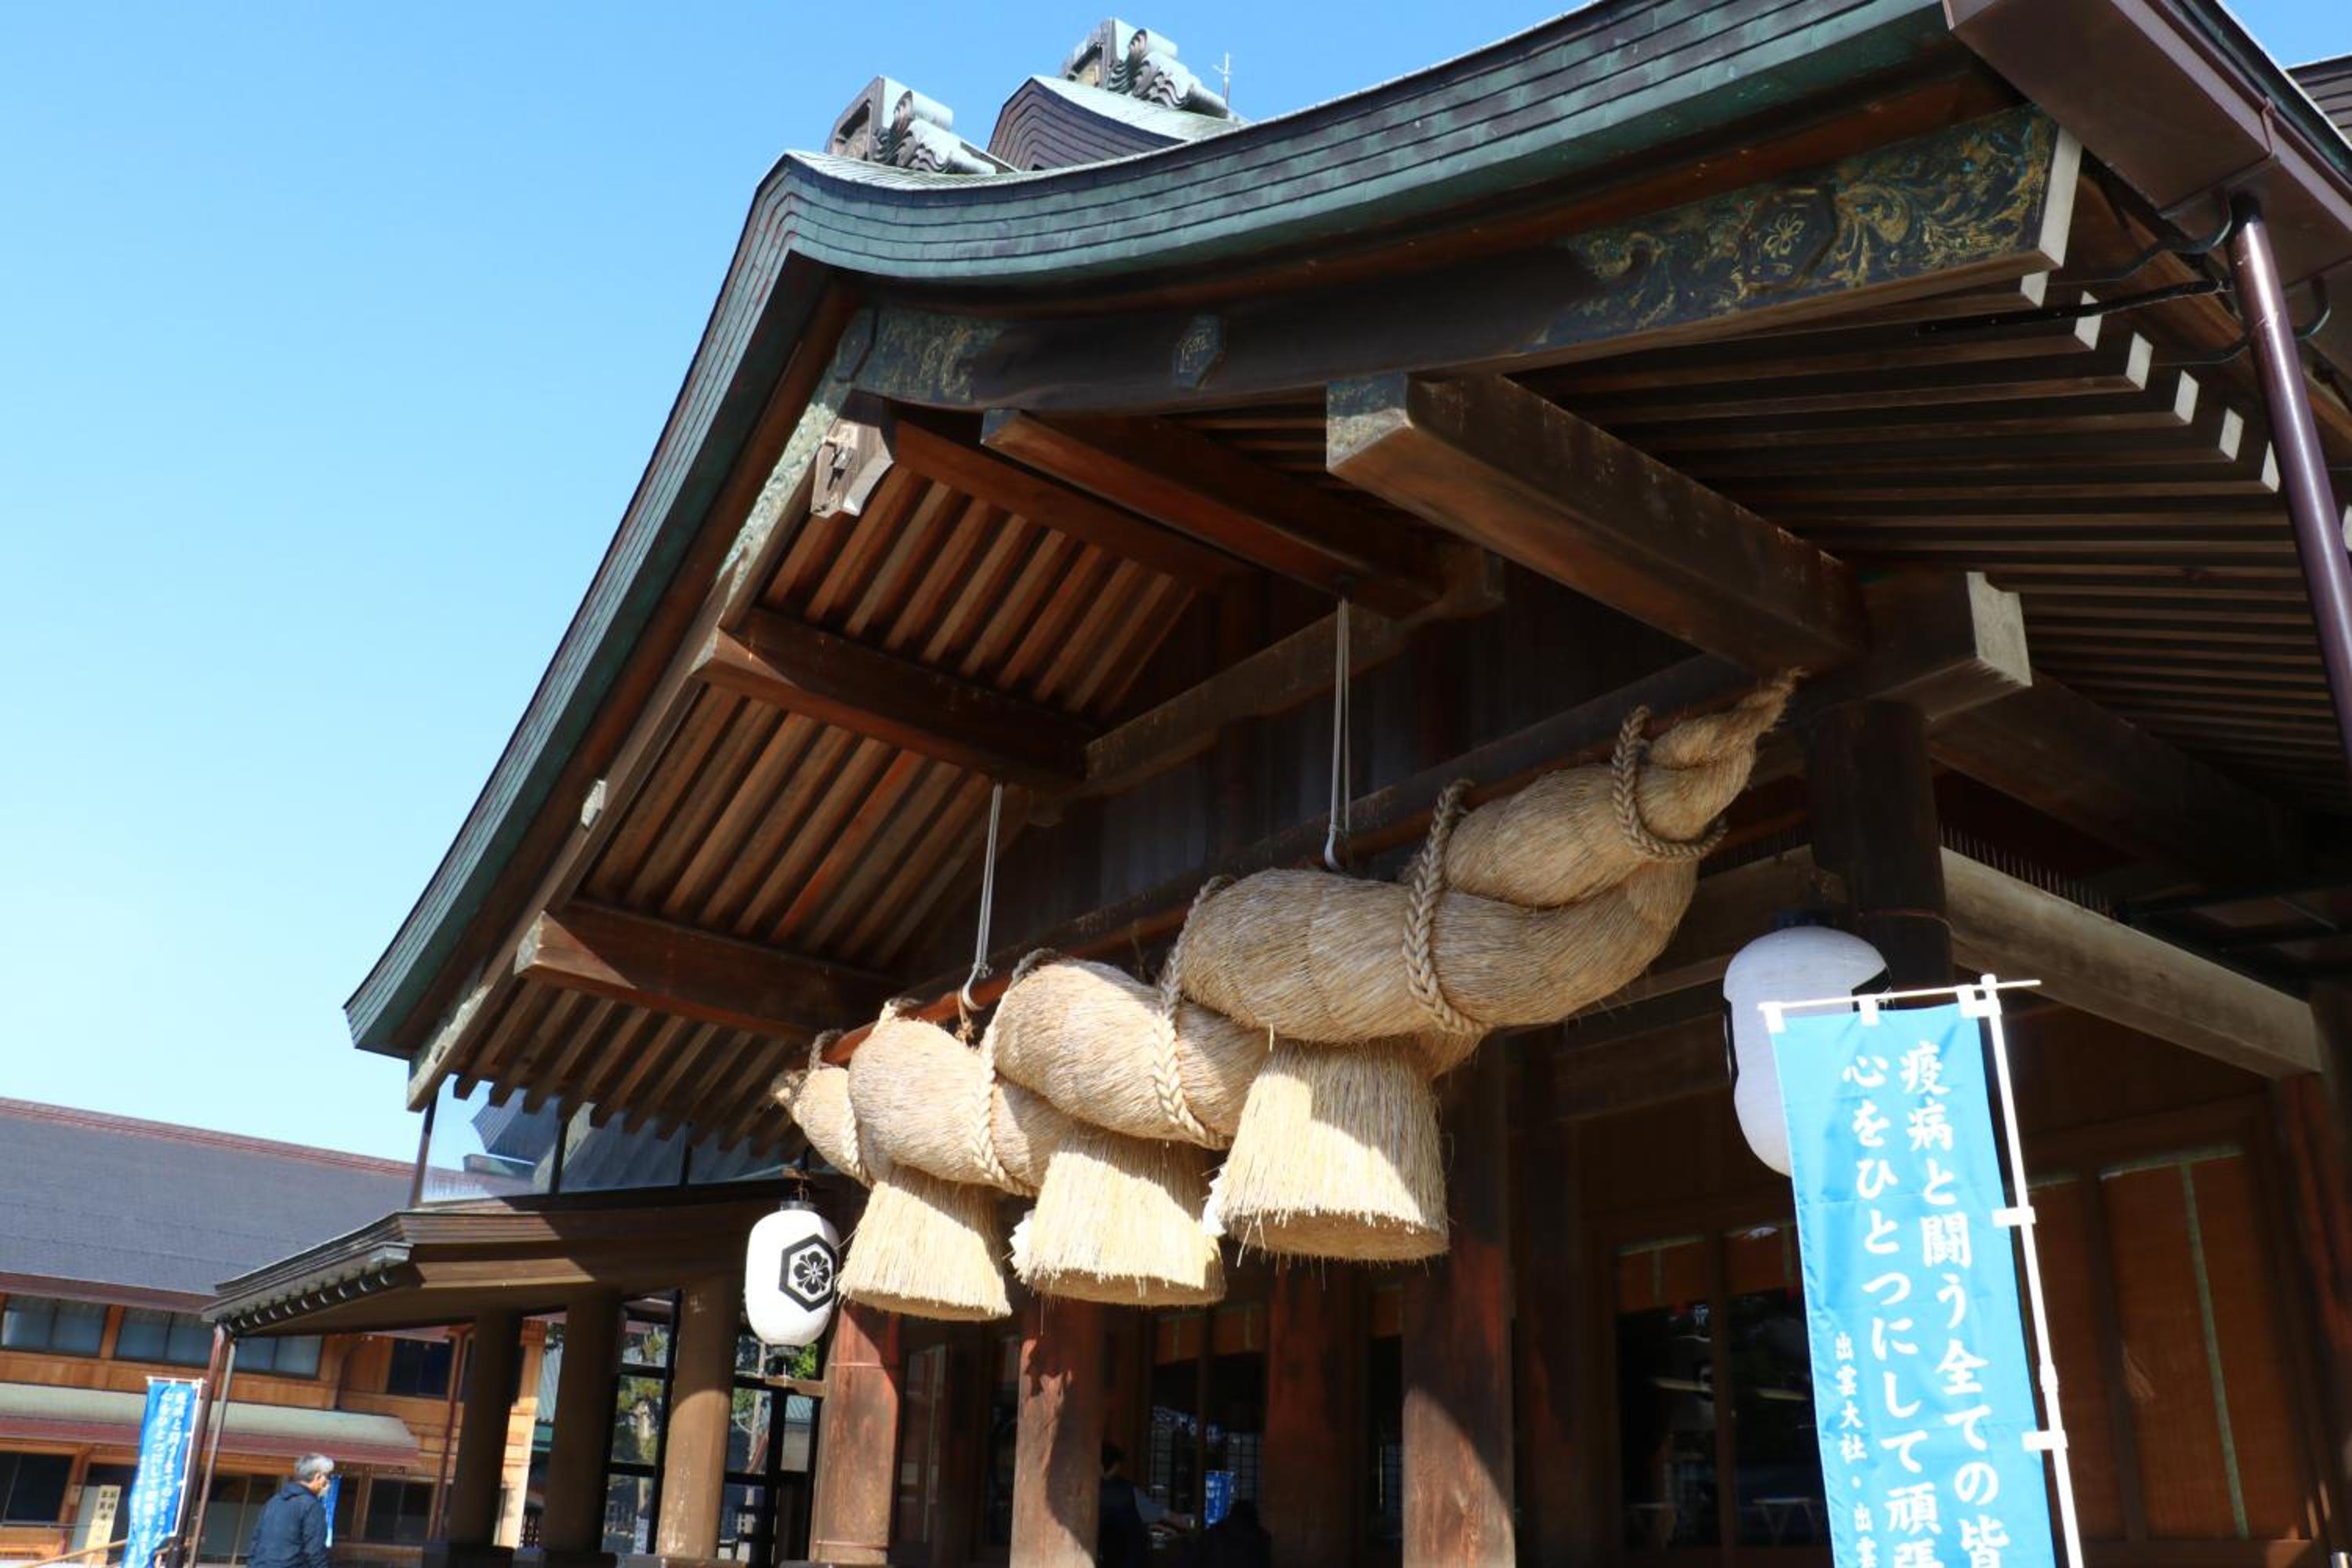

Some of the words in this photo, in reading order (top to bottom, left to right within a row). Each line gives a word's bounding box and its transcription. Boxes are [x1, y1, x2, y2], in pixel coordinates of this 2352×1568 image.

[1899, 1040, 2010, 1568] 疫病と闘う全ての皆
